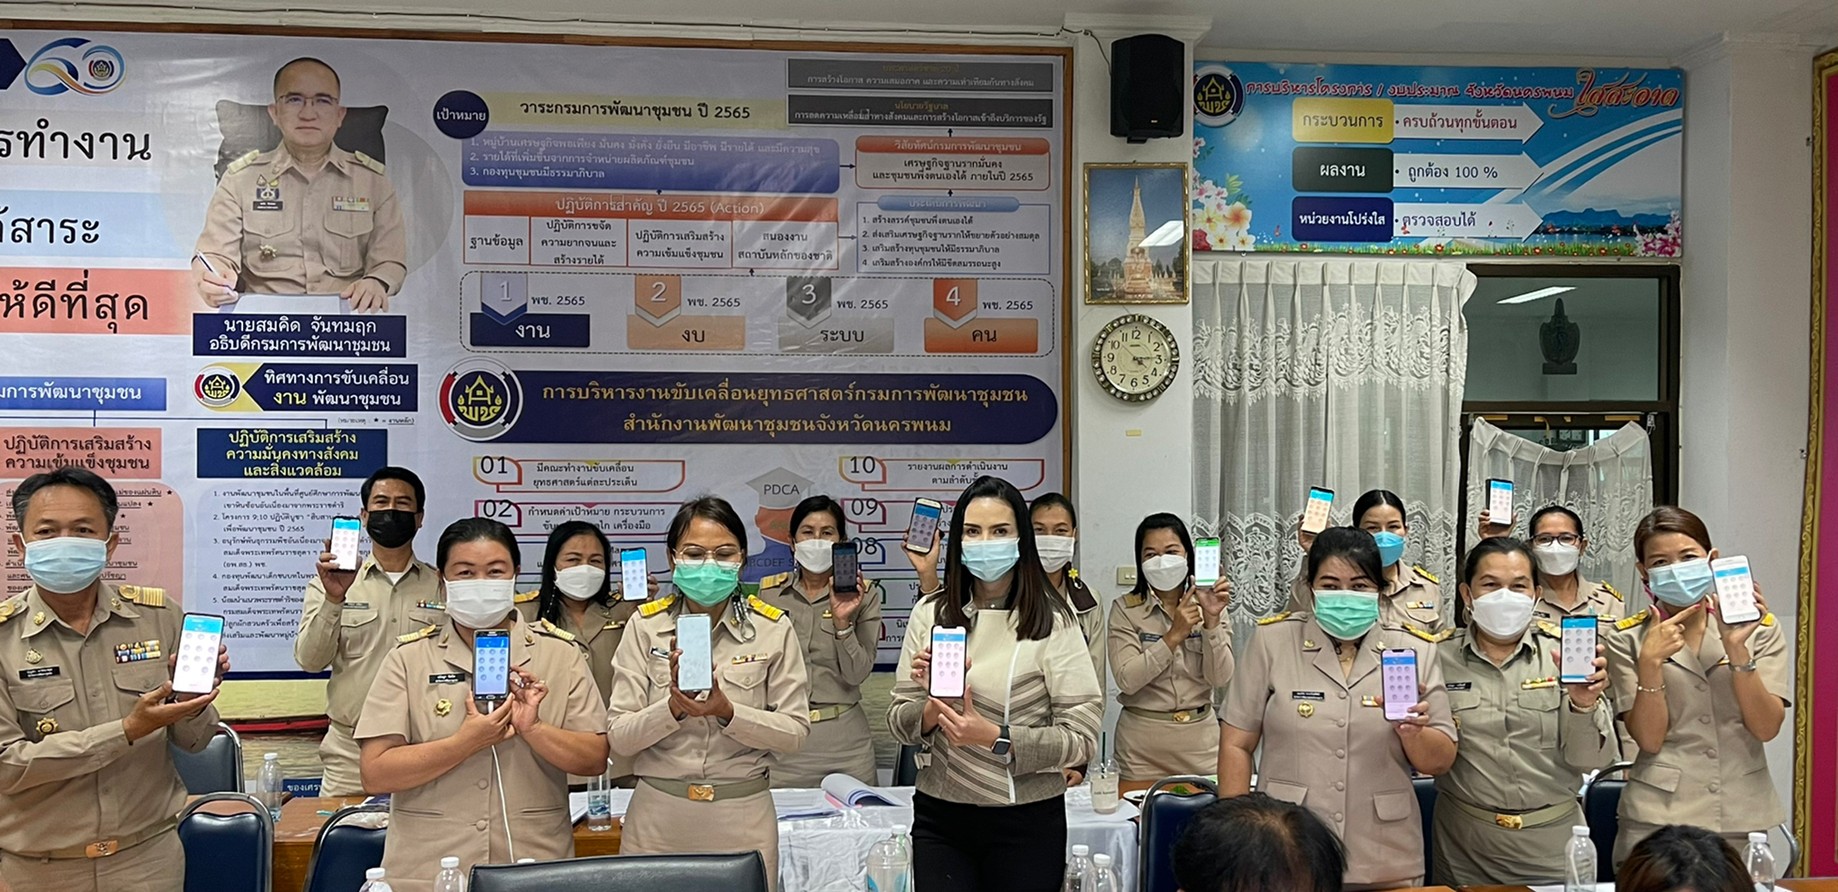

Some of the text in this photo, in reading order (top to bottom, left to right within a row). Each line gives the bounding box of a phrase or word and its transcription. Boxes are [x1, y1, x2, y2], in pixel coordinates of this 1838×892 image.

[1246, 77, 1372, 95] การบริหารโครงการ
[1388, 82, 1459, 97] งบประมาณ
[1465, 82, 1574, 99] จังหวัดนครพนม
[436, 107, 486, 122] เป้าหมาย
[520, 100, 750, 122] วาระกรมการพัฒนาชุมชน ปี 2565
[1303, 109, 1517, 132] กระบวนการ ครบถ้วนทุกขั้นตอน
[483, 167, 604, 179] กองทุนชุมชนมีธรรมาภิบาล
[1010, 173, 1033, 181] 2565
[1320, 163, 1498, 182] ผลงาน ถูกต้อง 100 %
[658, 200, 667, 213] ปี
[672, 202, 705, 213] 2565
[710, 202, 764, 215] (Action)
[546, 219, 612, 234] ปฏิบัติการขจัด
[1299, 211, 1476, 227] หน่วยงานโปร่งใส ตรวจสอบได้
[470, 233, 523, 250] ฐานข้อมูล
[541, 238, 617, 248] ความยากจนและ
[635, 229, 725, 245] ปฏิบัติการเสริมสร้าง
[553, 255, 605, 265] สร้างรายได้
[500, 281, 512, 301] 1
[556, 296, 586, 306] 2565
[651, 282, 666, 302] 2
[712, 297, 741, 308] 2565
[801, 284, 817, 304] 3
[861, 299, 889, 310] 2565
[946, 286, 961, 306] 4
[1006, 300, 1033, 311] 2565
[224, 316, 376, 337] นายสมคิด จันทมฤก
[515, 322, 551, 339] งาน
[681, 328, 705, 343] งบ
[820, 328, 865, 343] ระบบ
[971, 328, 997, 343] คน
[210, 334, 391, 356] อธิบดีกรมการพัฒนาชุมชน
[264, 367, 409, 386] ทิศทางการขับเคลื่อน
[273, 389, 401, 409] งาน พัฒนาชุมชน
[543, 378, 1028, 408] การบริหารงานขับเคลื่อนยุทธศาสตร์กรมการพัฒนาชุมชน
[623, 412, 951, 438] สำนักงานพัฒนาชุมชนจังหวัดนครพนม
[4, 434, 152, 454] ปฏิบัติการเสริมสร้าง
[229, 429, 357, 447] ปฏิบัติการเสริมสร้าง
[226, 443, 359, 462] ความมั่นคงทางสังคม
[6, 452, 150, 474] ความเข้มแข็งชุมชน
[244, 459, 342, 476] และสิ่งแวดล้อม
[480, 455, 508, 475] 01
[537, 459, 634, 473] มีคณะทำงานขับเคลื่อน
[850, 455, 876, 474] 10
[533, 475, 638, 489] ยุทธศาสตร์แต่ละประเด็น
[764, 484, 800, 495] PDCA
[483, 499, 513, 518] 02
[528, 506, 665, 517] กำหนดค่าเป้าหมาย กระบวนการ
[851, 498, 878, 516] 09
[613, 520, 651, 530] เครื่องมือ
